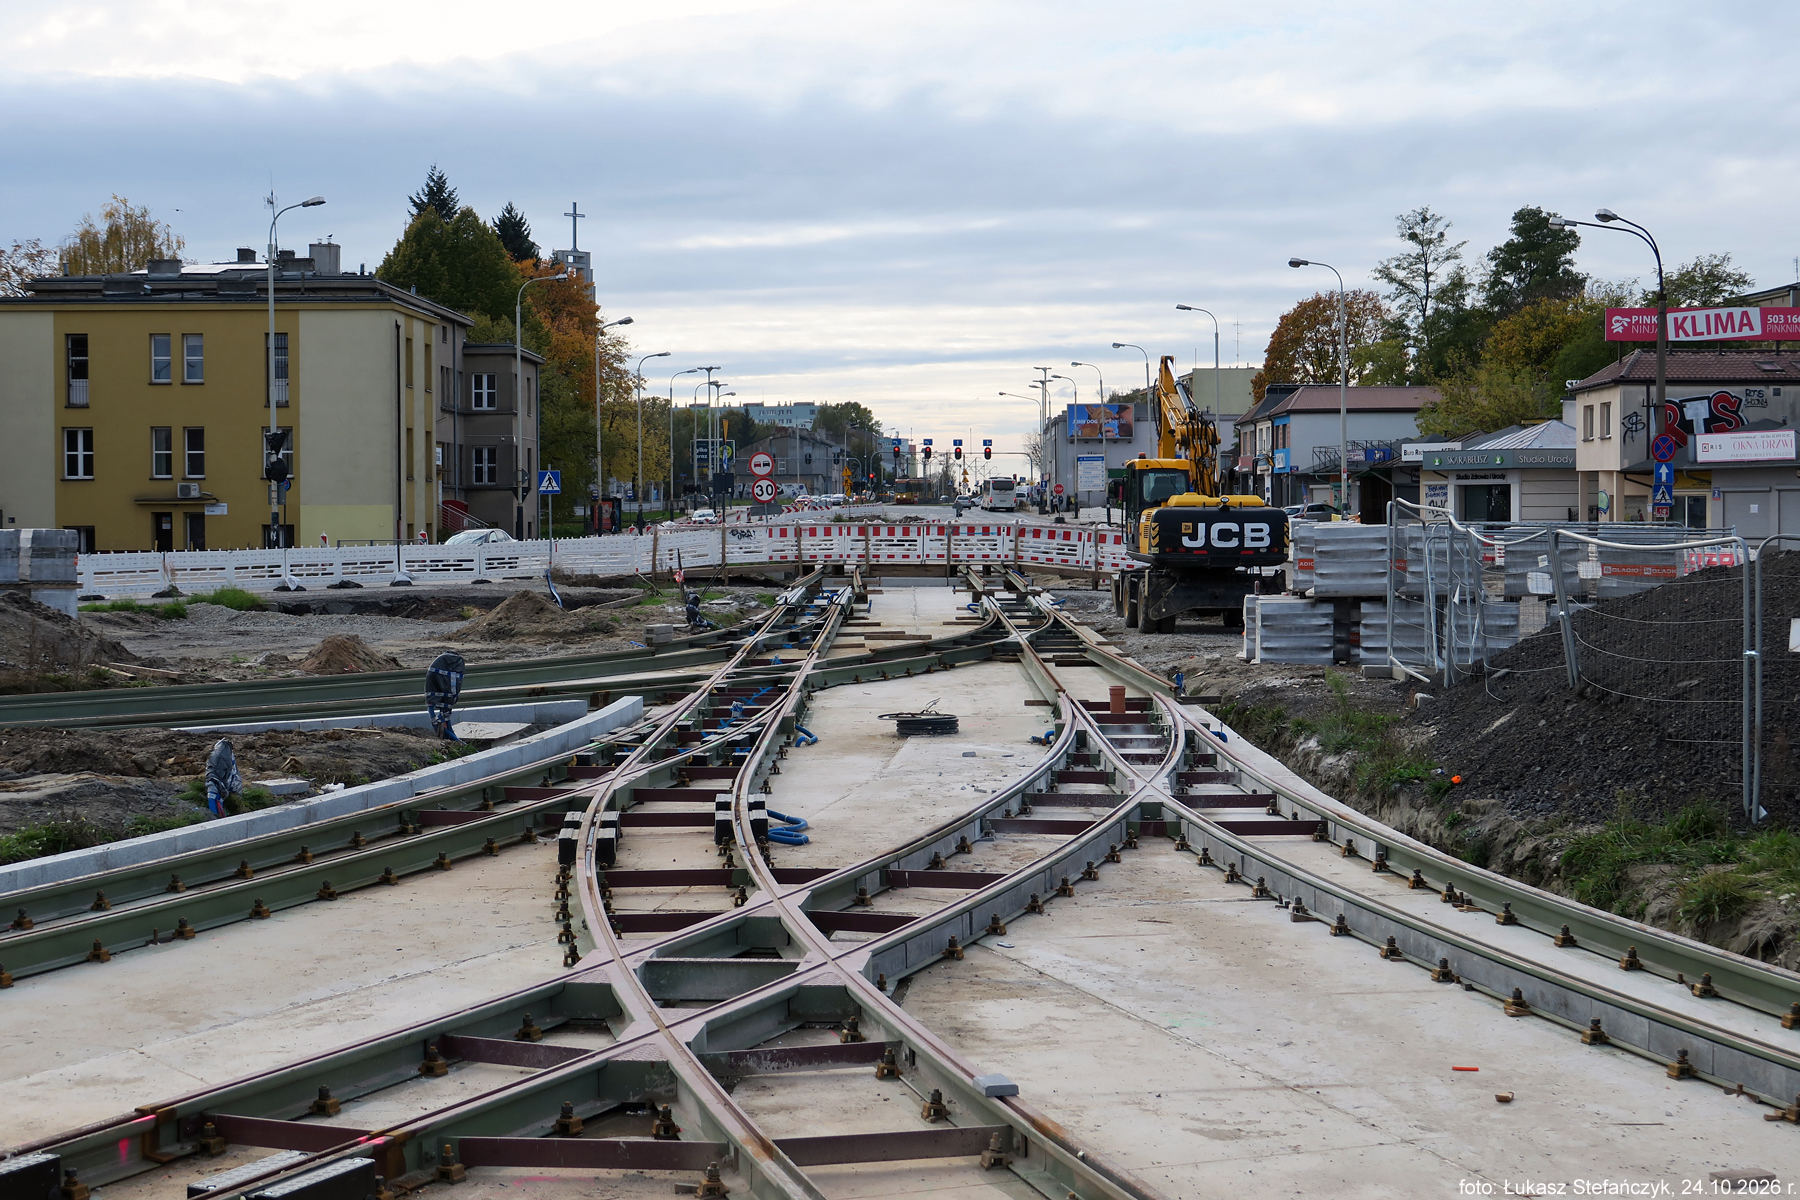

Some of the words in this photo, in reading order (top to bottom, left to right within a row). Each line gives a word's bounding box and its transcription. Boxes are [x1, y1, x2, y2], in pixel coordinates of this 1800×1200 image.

[1632, 315, 1658, 324] PINK
[1673, 310, 1755, 338] KLIMA
[1767, 314, 1785, 324] 503
[1745, 388, 1765, 398] RTS
[1732, 440, 1759, 451] OKNA
[1762, 438, 1793, 450] DRZWI
[1518, 454, 1545, 464] Studio
[1547, 455, 1574, 466] Urody
[755, 483, 774, 497] 30
[1181, 522, 1271, 548] JCB
